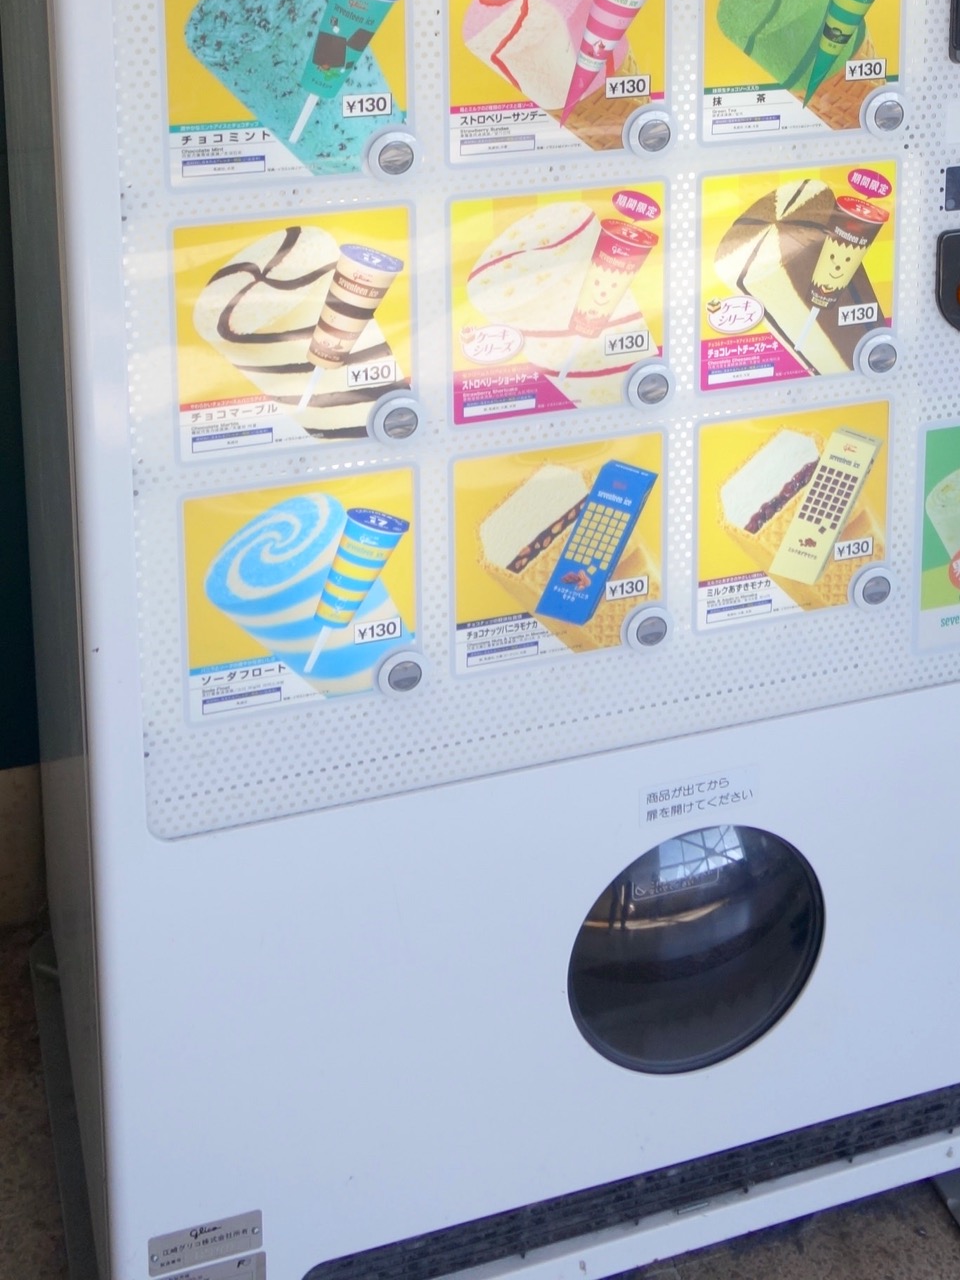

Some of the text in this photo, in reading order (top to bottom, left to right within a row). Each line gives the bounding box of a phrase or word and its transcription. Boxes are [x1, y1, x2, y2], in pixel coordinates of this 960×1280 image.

[849, 62, 882, 76] ¥130
[610, 79, 646, 94] ¥130
[347, 97, 387, 114] ¥130
[460, 110, 547, 126] ストロベリーサンデー
[181, 130, 271, 146] チョコミント
[851, 171, 889, 196] 期間限定
[616, 192, 658, 218] 期間限定
[722, 302, 752, 314] ケーキ
[842, 307, 875, 323] ¥130
[718, 312, 755, 327] シリーズ
[477, 329, 509, 343] ケーキ
[609, 335, 645, 351] ¥130
[474, 341, 517, 356] シリーズ
[707, 341, 778, 358] チョコレートチーズケーキ
[352, 365, 391, 382] ¥130
[462, 372, 539, 390] ストロベリーショートケーキ
[191, 404, 278, 423] チョコマーブル
[838, 540, 870, 557] ¥130
[609, 580, 645, 597] ¥130
[706, 578, 771, 598] ミルクあずきモナカ
[358, 621, 397, 640] ¥130
[466, 620, 538, 640] チョコナッツバニラモナカ
[201, 664, 286, 686] ソーダフロート
[647, 777, 730, 805] 商品が出てから
[646, 789, 753, 822] 扉を開けてください
[189, 1226, 222, 1240] Glico
